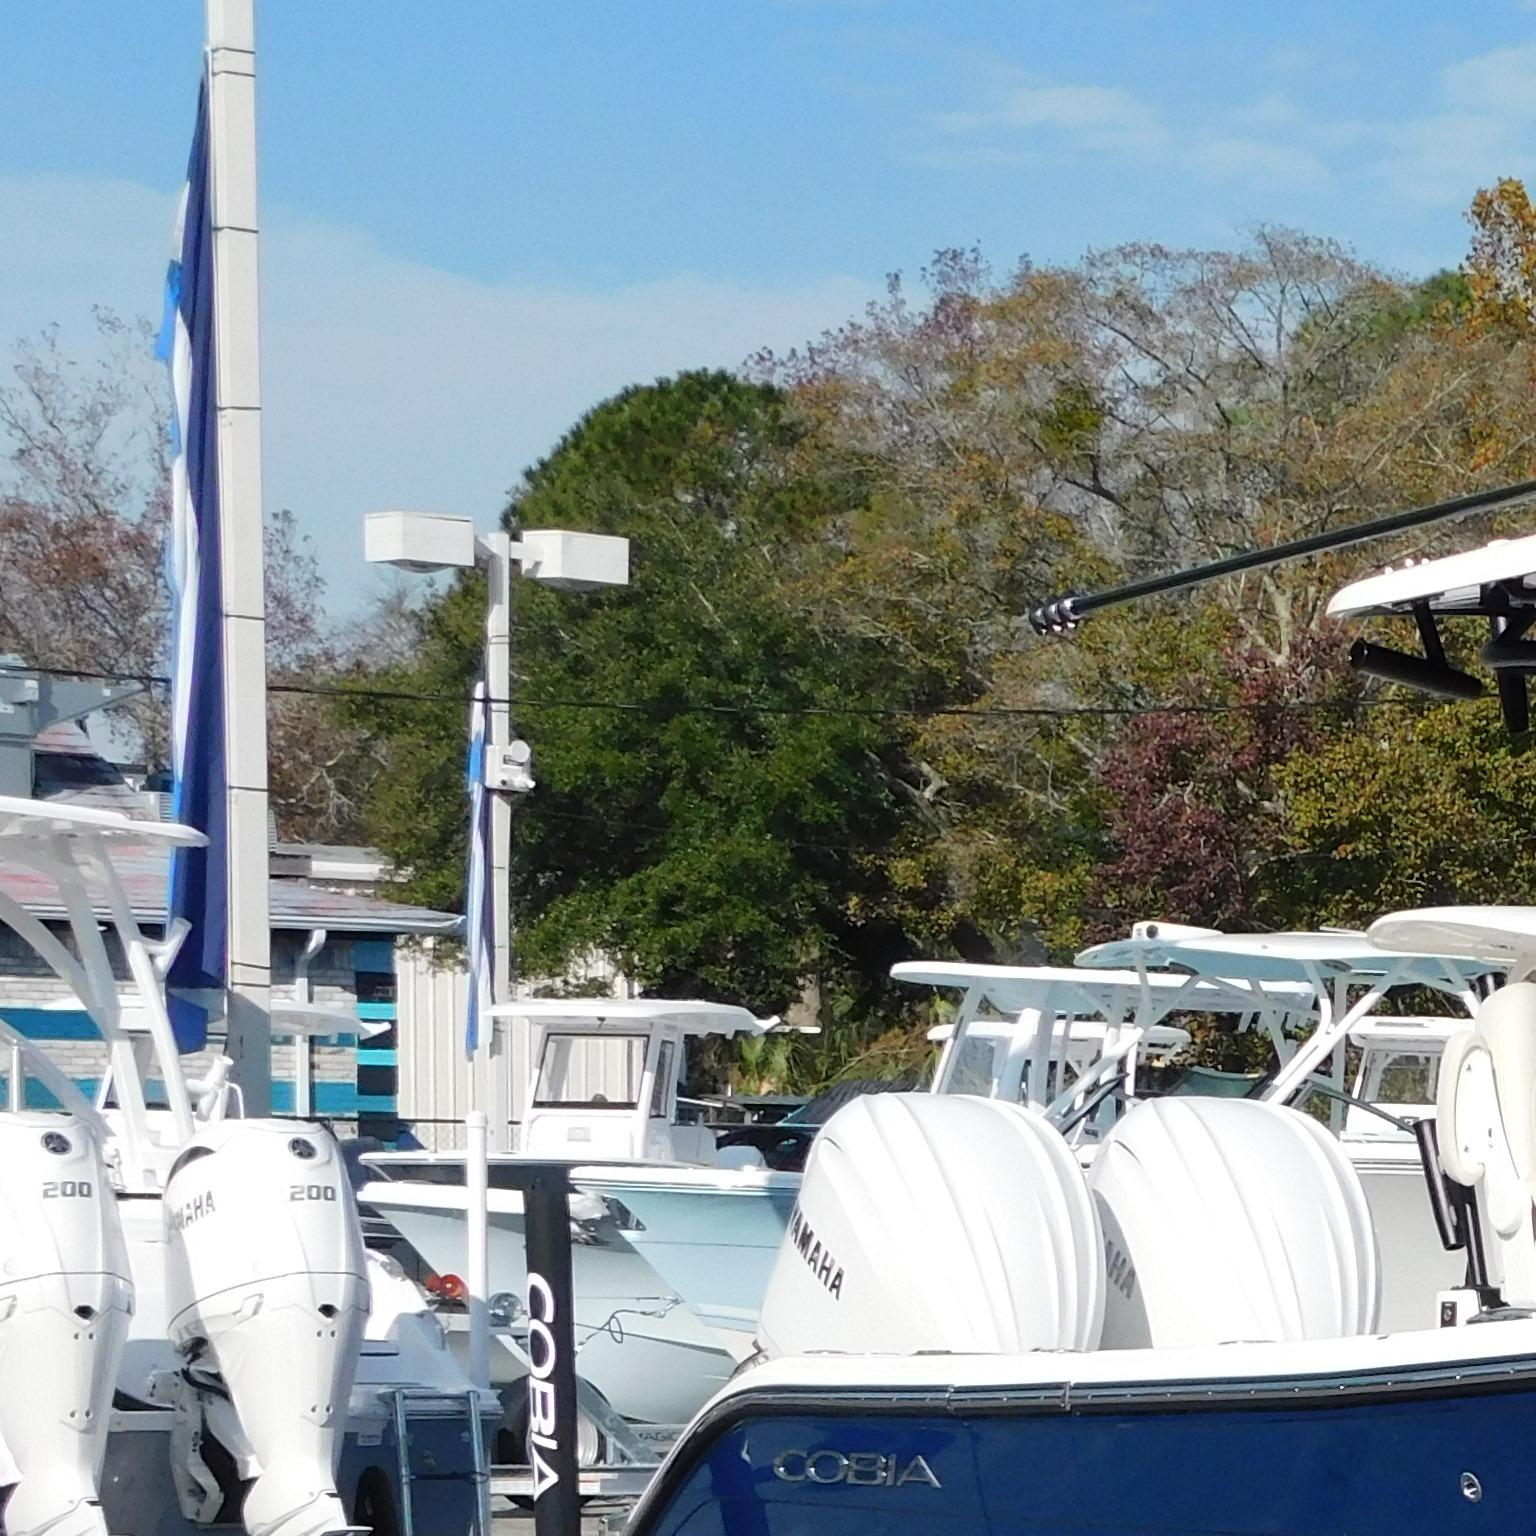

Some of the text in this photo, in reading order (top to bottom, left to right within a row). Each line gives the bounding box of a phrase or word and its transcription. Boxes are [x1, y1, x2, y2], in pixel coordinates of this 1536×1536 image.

[42, 1181, 92, 1199] 200
[289, 1185, 336, 1201] 200
[528, 1272, 559, 1502] COBIA
[773, 1449, 943, 1489] COBIA
